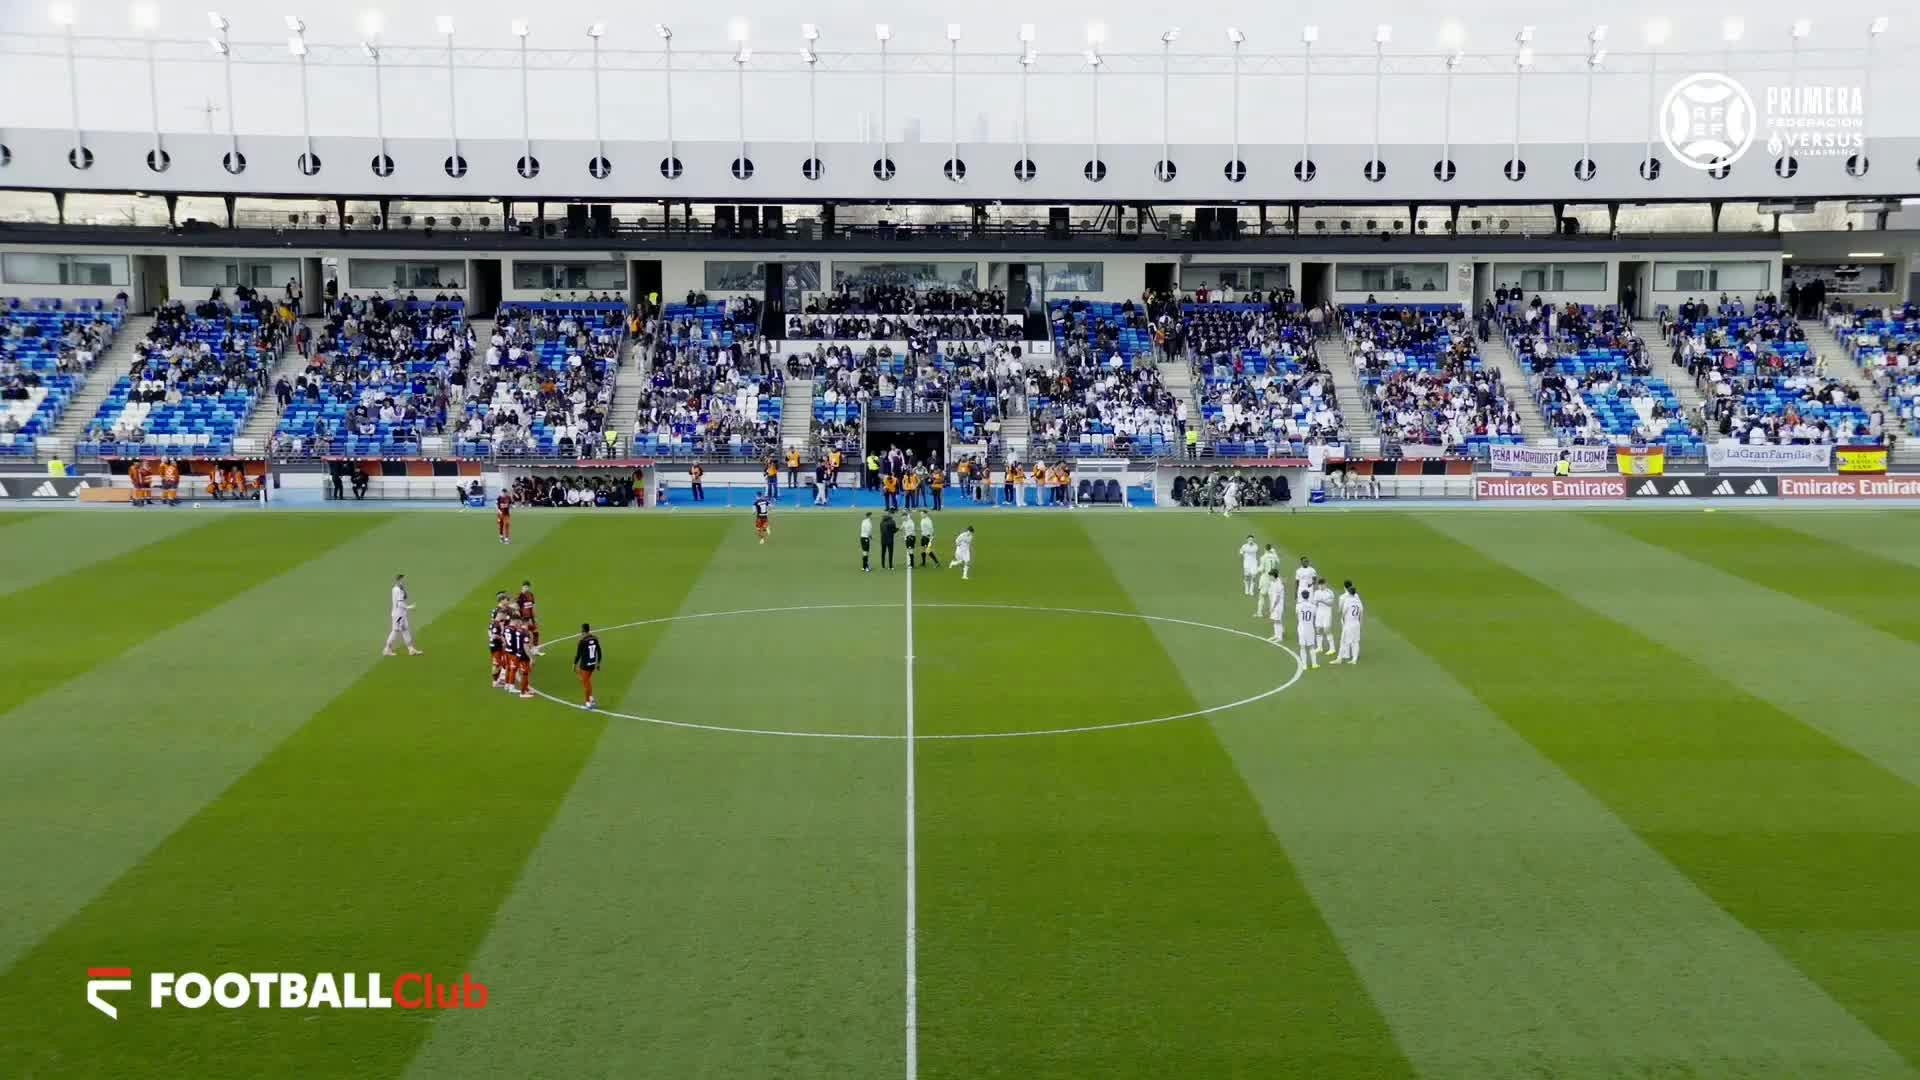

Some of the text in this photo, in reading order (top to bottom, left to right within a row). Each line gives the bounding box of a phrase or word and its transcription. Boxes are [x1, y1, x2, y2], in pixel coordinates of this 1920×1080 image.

[1477, 480, 1549, 497] Emirates
[1552, 480, 1625, 497] Emirates
[1782, 479, 1856, 495] Emirates
[1859, 479, 1920, 495] Emirat
[1301, 610, 1312, 622] 10
